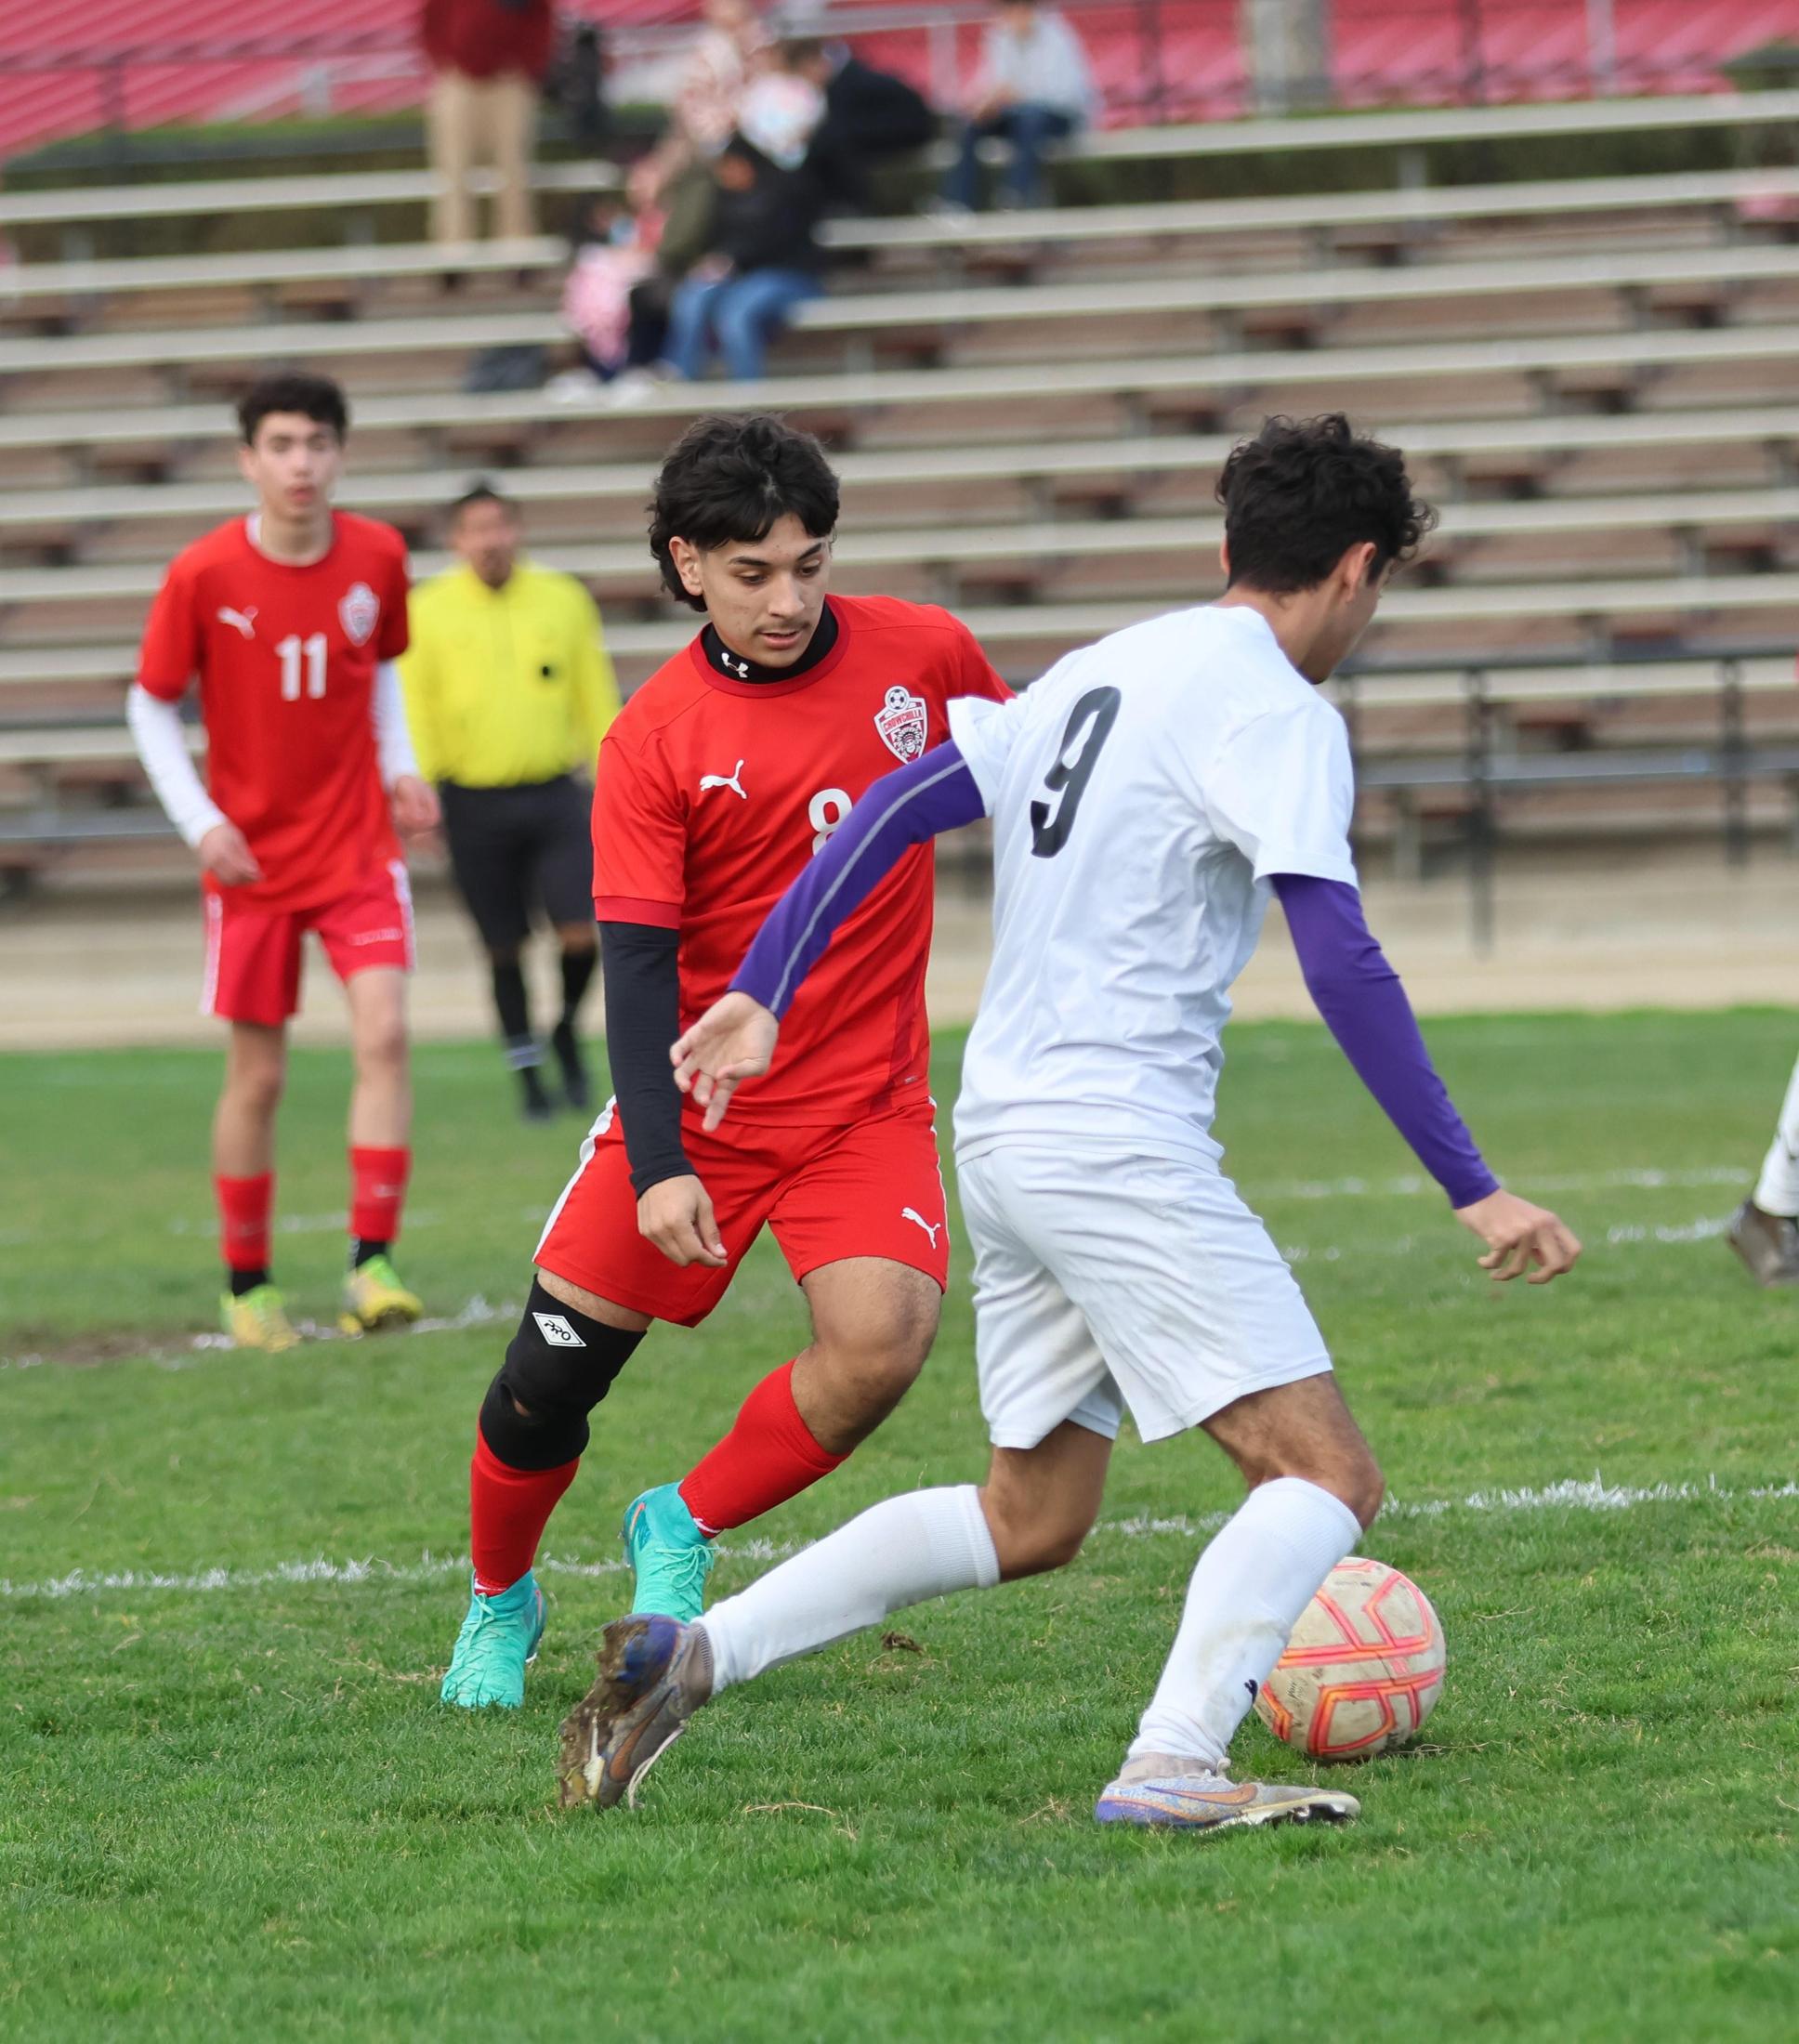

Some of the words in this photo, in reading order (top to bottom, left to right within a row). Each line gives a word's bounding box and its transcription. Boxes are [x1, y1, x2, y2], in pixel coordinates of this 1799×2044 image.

[274, 632, 327, 701] 11
[1030, 686, 1122, 858] 9
[808, 788, 853, 856] 8
[544, 1319, 571, 1342] PRO
